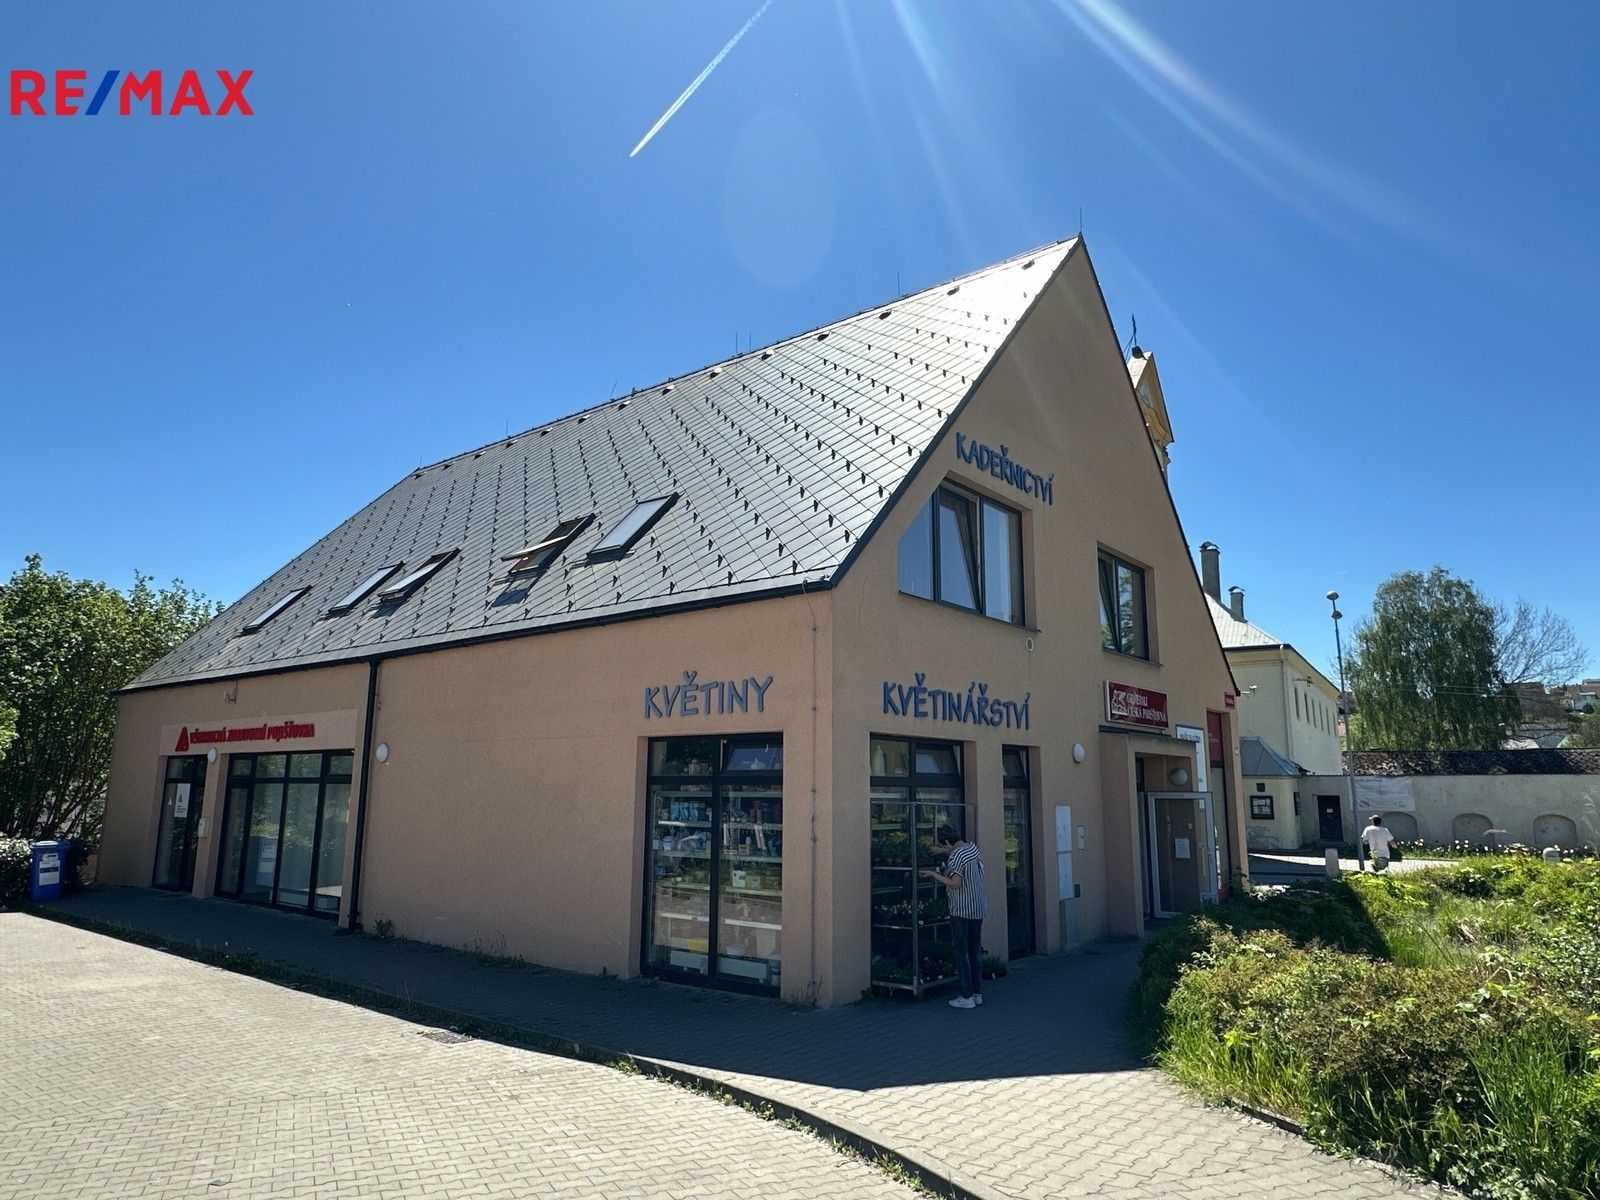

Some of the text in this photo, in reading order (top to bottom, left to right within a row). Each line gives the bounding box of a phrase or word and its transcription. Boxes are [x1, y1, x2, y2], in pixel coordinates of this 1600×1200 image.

[955, 431, 1055, 506] KADEŘNICTVÍ
[644, 670, 774, 719] KVĚTINY
[883, 672, 1031, 730] KVĚTINÁŘSTVÍ
